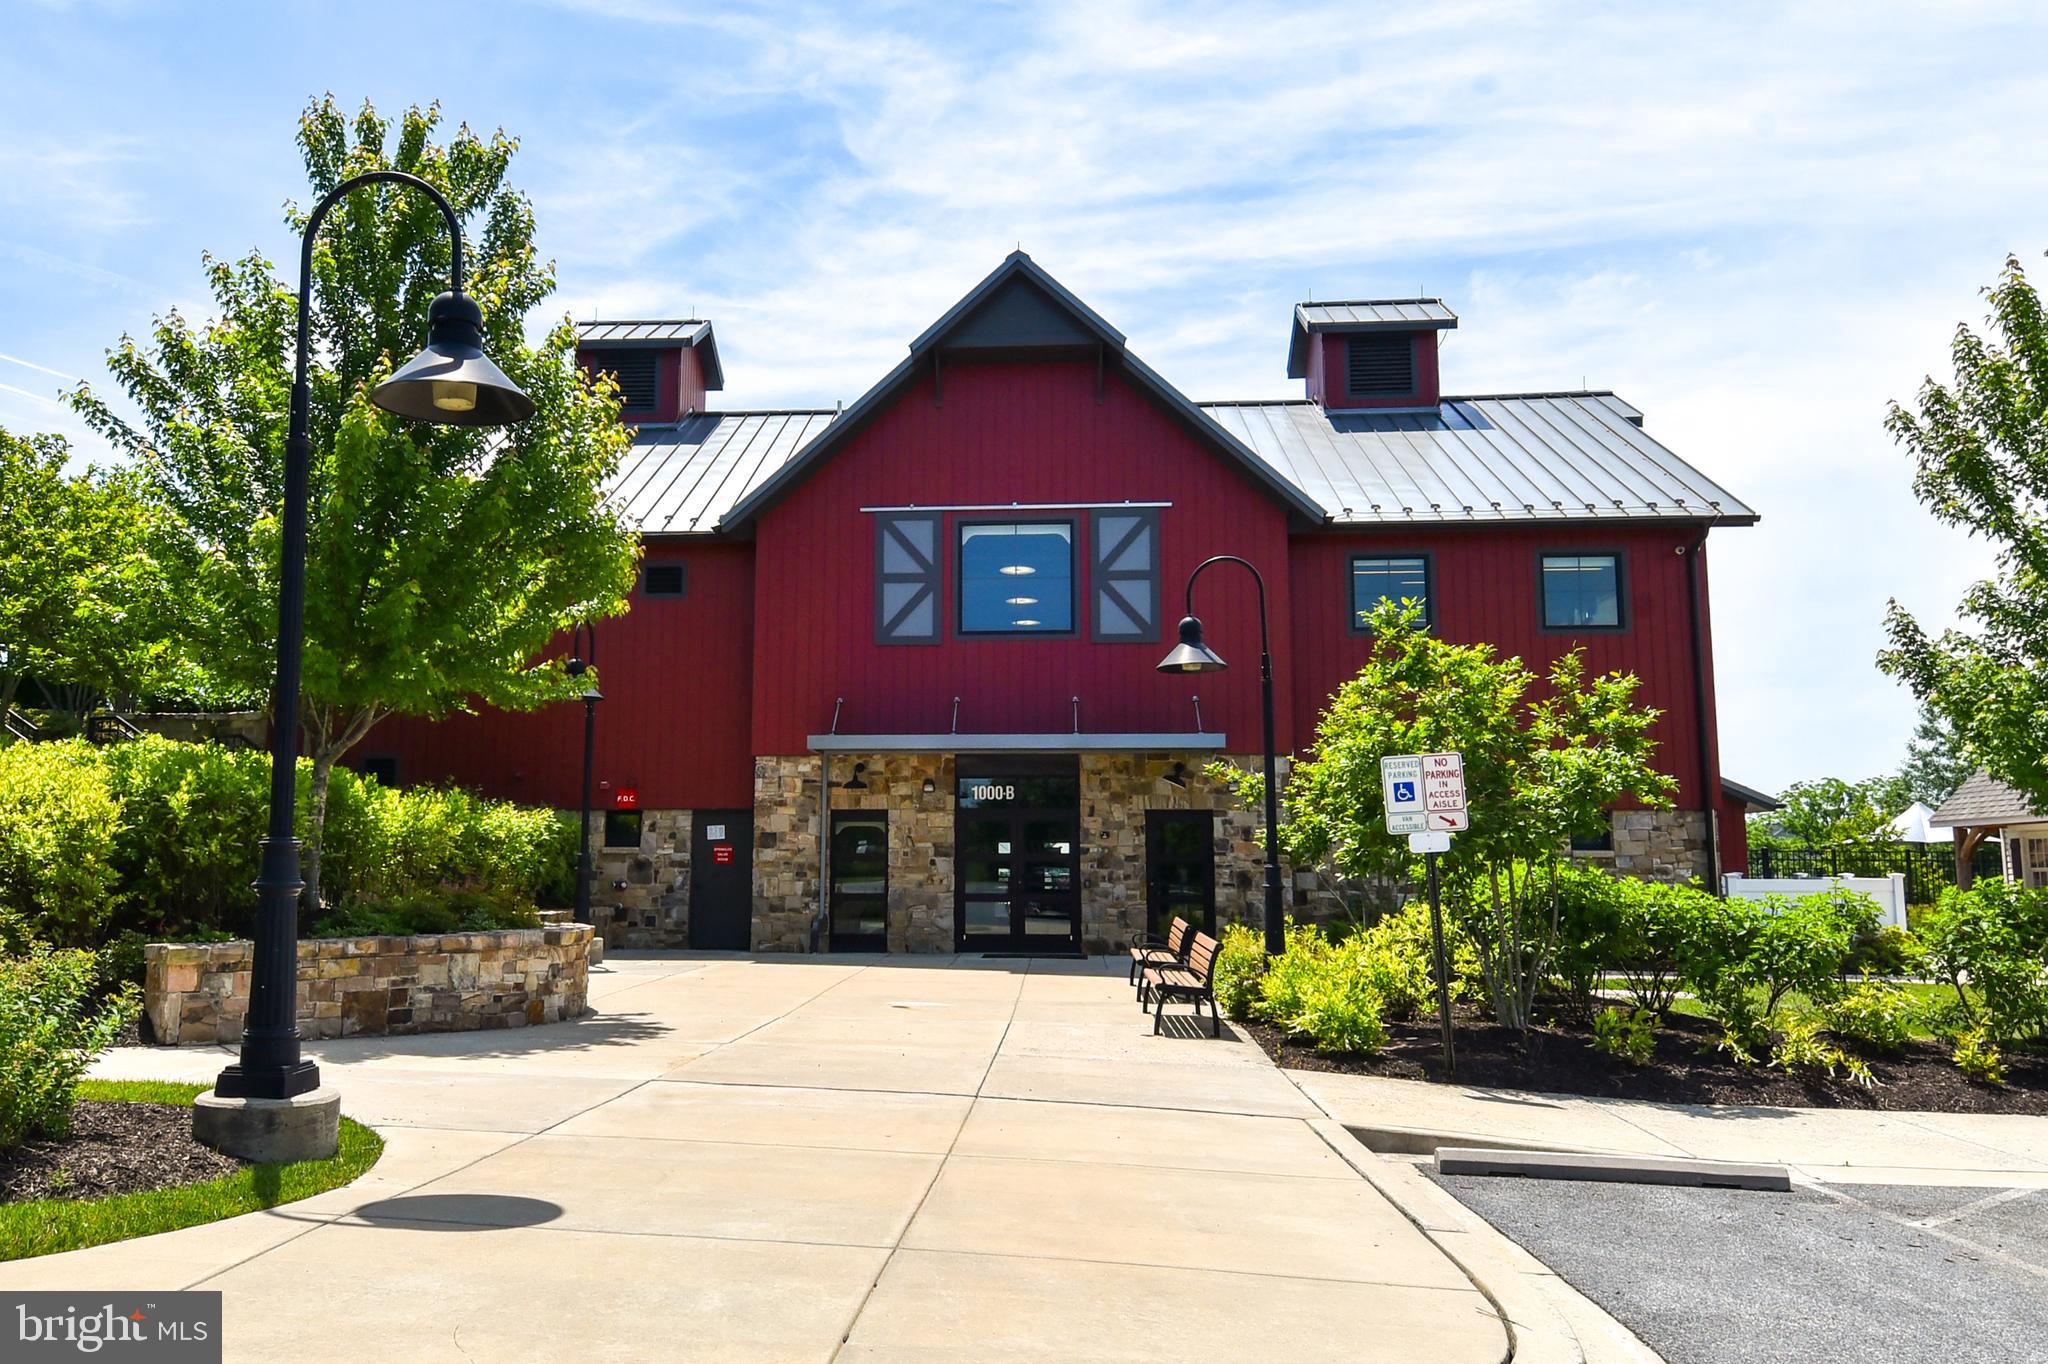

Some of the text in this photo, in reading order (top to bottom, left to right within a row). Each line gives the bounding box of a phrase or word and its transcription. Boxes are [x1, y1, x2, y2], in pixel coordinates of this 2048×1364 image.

[1384, 761, 1420, 770] RESERVED
[1434, 758, 1448, 767] NO
[1387, 770, 1418, 779] PARKING
[1425, 769, 1460, 780] PARKING
[1439, 780, 1448, 788] IN
[1429, 790, 1461, 799] ACCESS
[1432, 799, 1459, 808] AISLE
[1391, 822, 1424, 831] ACCESSIBLE
